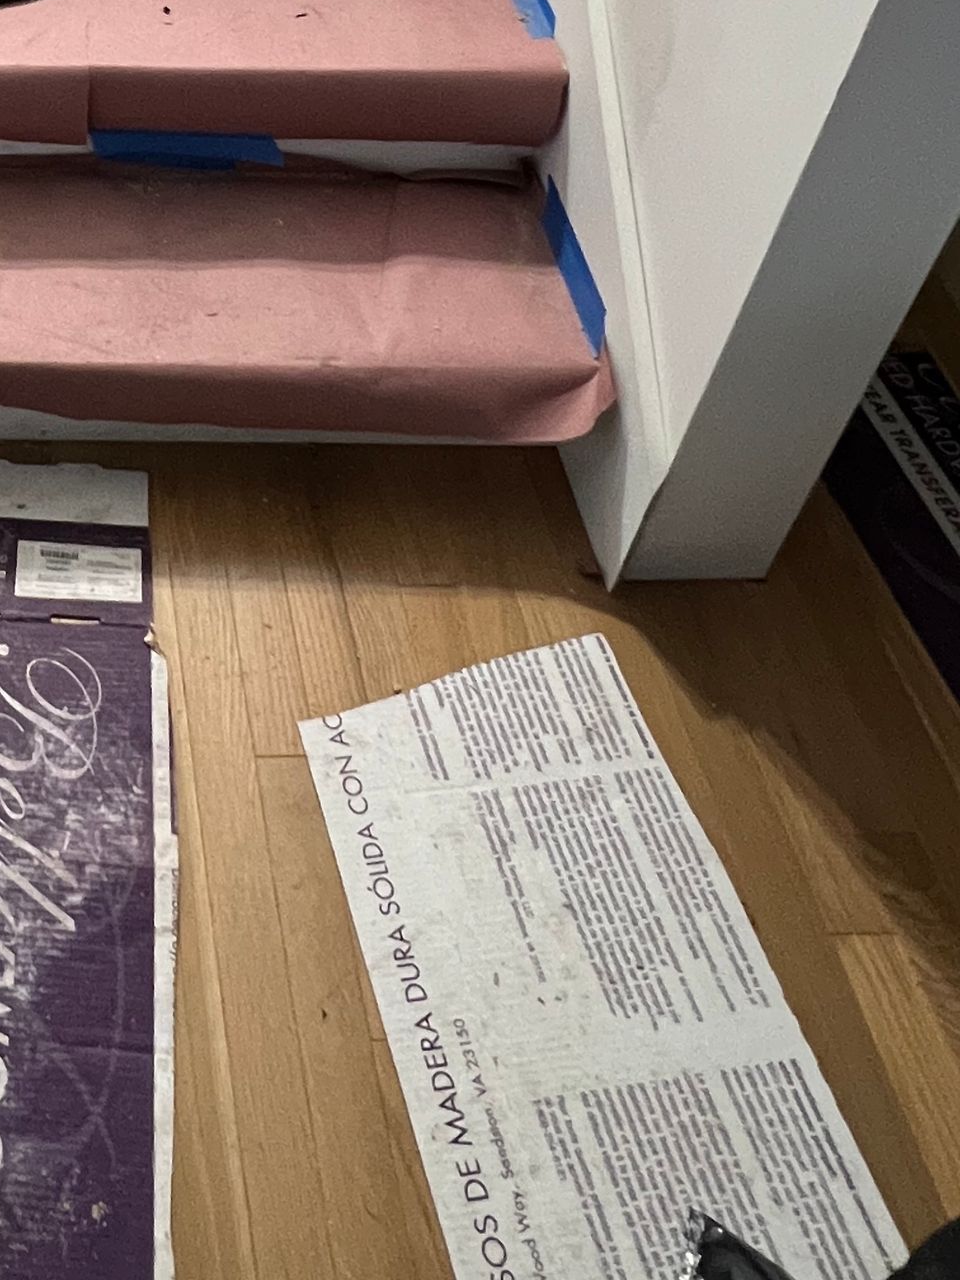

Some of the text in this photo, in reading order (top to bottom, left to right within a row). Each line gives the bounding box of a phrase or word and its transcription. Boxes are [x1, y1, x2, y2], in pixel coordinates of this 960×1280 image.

[334, 754, 369, 816] CON
[357, 821, 402, 916] SÓLIDA
[387, 923, 429, 1004] DURA
[452, 1017, 481, 1071] 23150
[414, 1011, 474, 1147] MADERA
[471, 1073, 488, 1099] VA
[455, 1158, 490, 1203] DE
